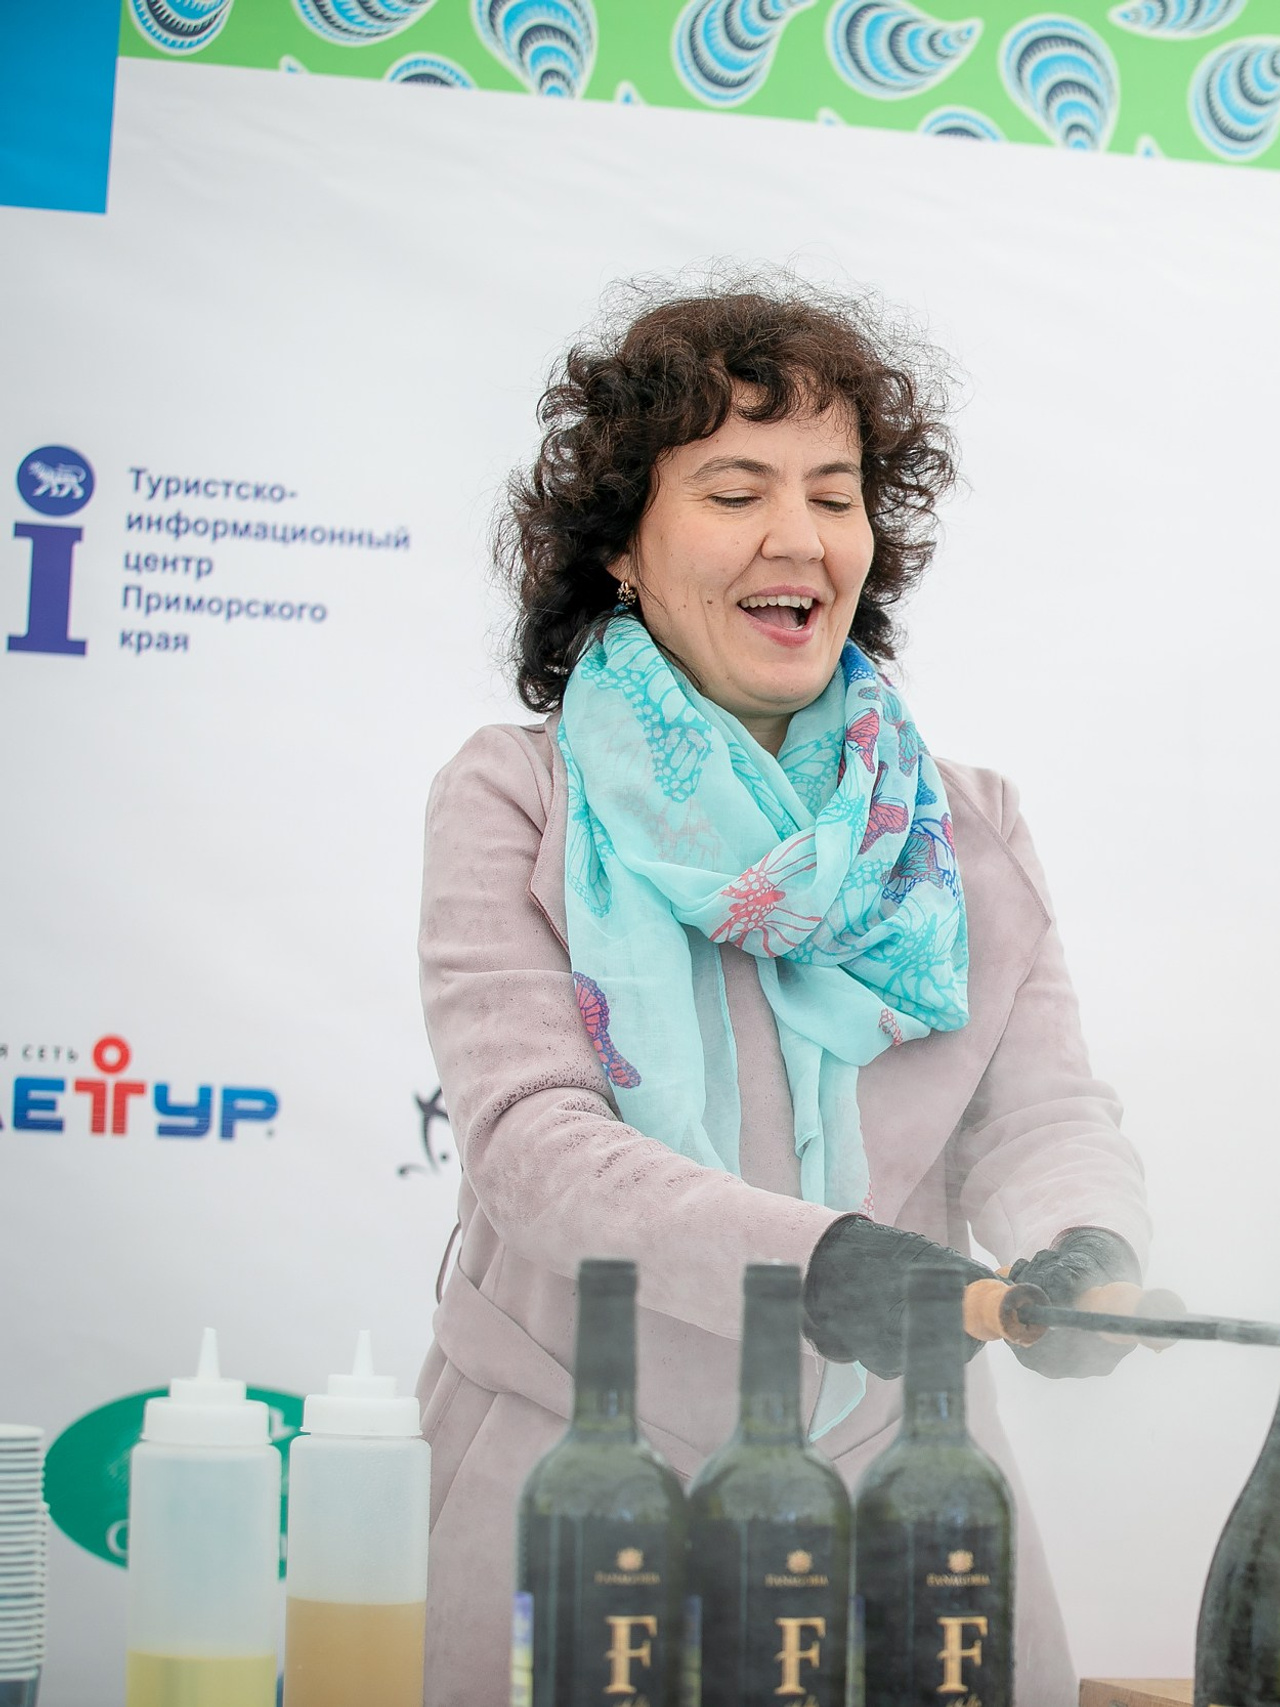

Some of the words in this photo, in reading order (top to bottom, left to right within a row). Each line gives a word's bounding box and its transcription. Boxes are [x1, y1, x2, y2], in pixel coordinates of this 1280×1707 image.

[129, 467, 298, 503] Туристско-
[126, 511, 411, 550] информационный
[123, 551, 214, 579] центр
[122, 584, 328, 622] Приморского
[120, 629, 190, 654] края
[22, 1044, 79, 1064] СЕТЬ
[603, 1615, 658, 1694] F
[774, 1616, 827, 1695] F
[936, 1615, 989, 1694] F
